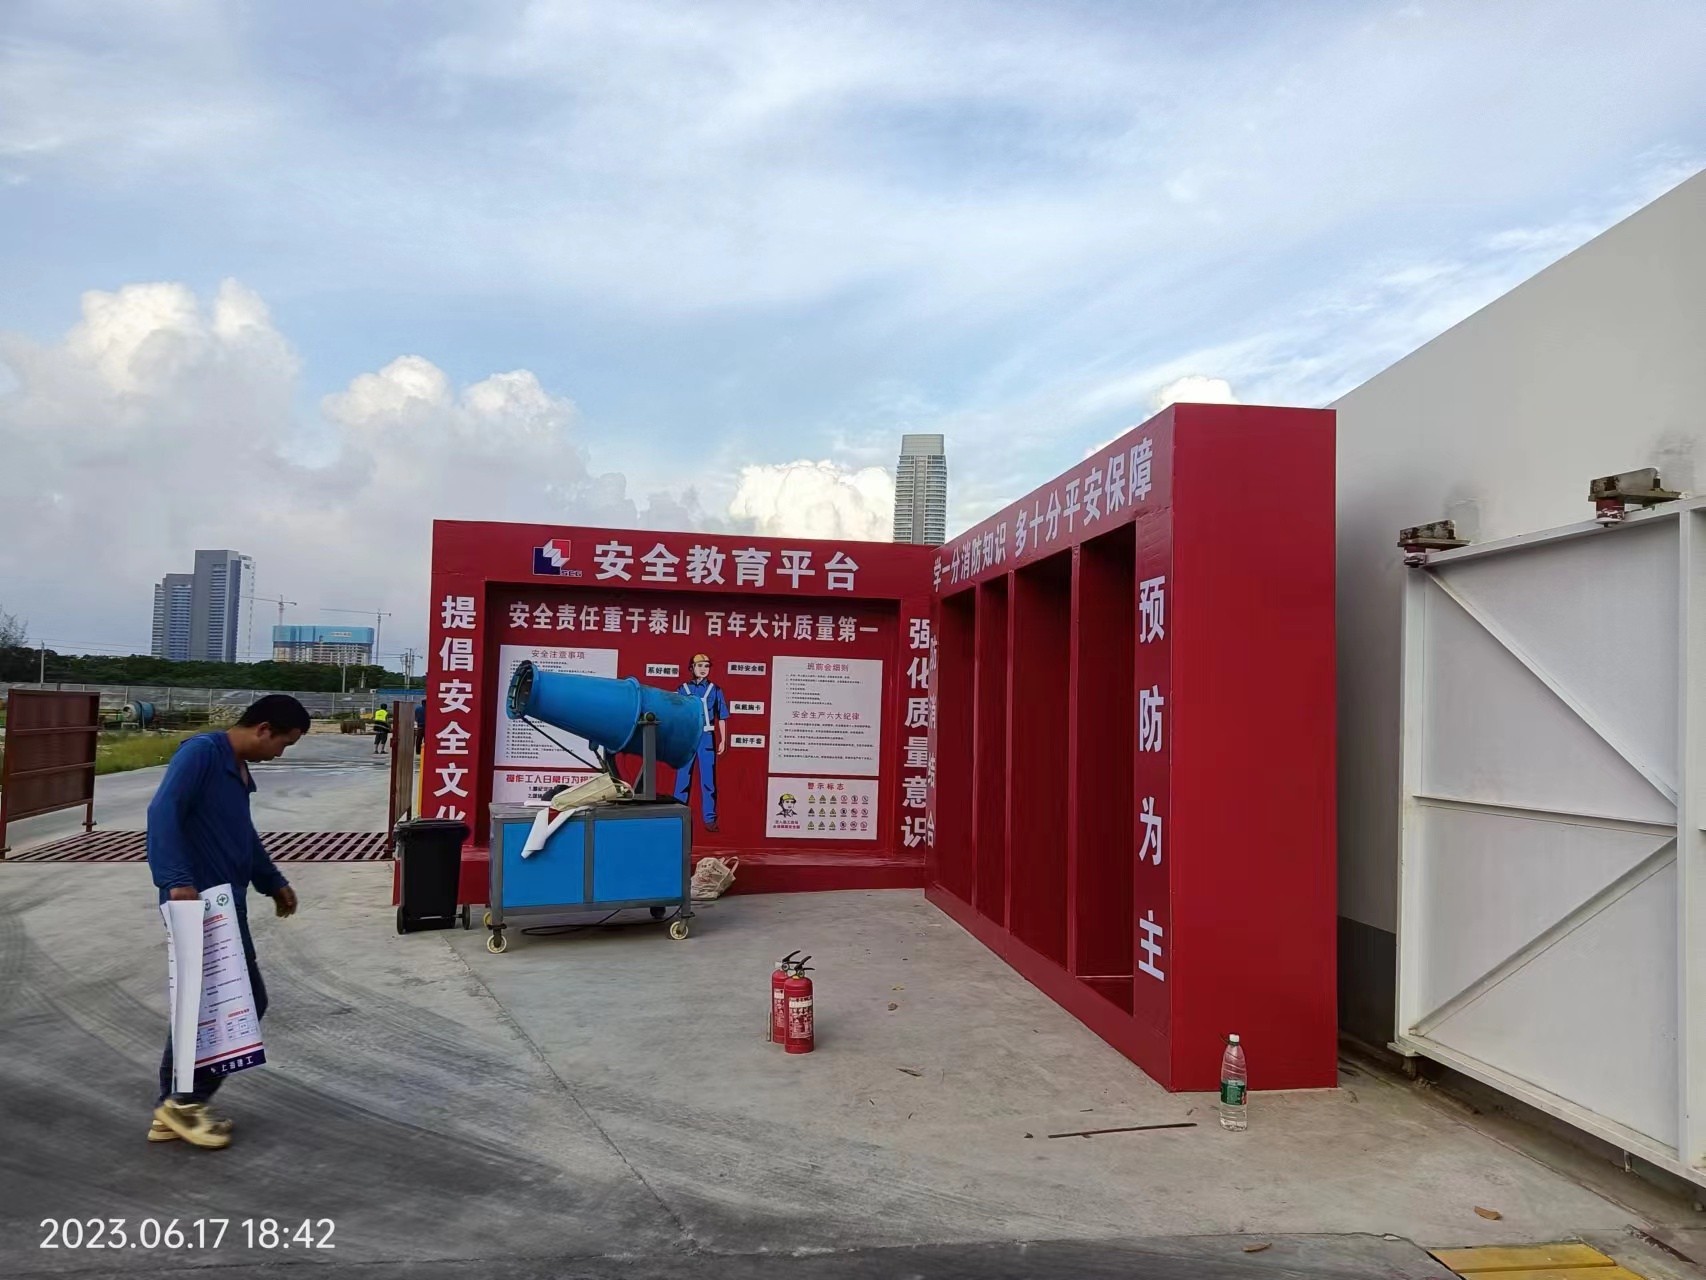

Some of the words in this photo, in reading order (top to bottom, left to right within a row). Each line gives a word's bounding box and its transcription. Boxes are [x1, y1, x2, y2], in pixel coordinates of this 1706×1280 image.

[933, 521, 1007, 592] 学一分消防知识
[1014, 437, 1153, 557] 多十分平安保障
[593, 541, 860, 591] 安全教育平台
[509, 602, 690, 637] 安全责任重于泰山
[706, 611, 879, 642] 百年大计质量第一
[531, 649, 585, 660] 安全注意事项
[807, 662, 849, 672] 班前会细则
[647, 666, 679, 675] 系好帽带
[792, 711, 860, 721] 安全生产六大纪律
[901, 618, 930, 848] 强化质量意识
[807, 782, 844, 791] 警示标志
[1138, 576, 1166, 981] 预防为主
